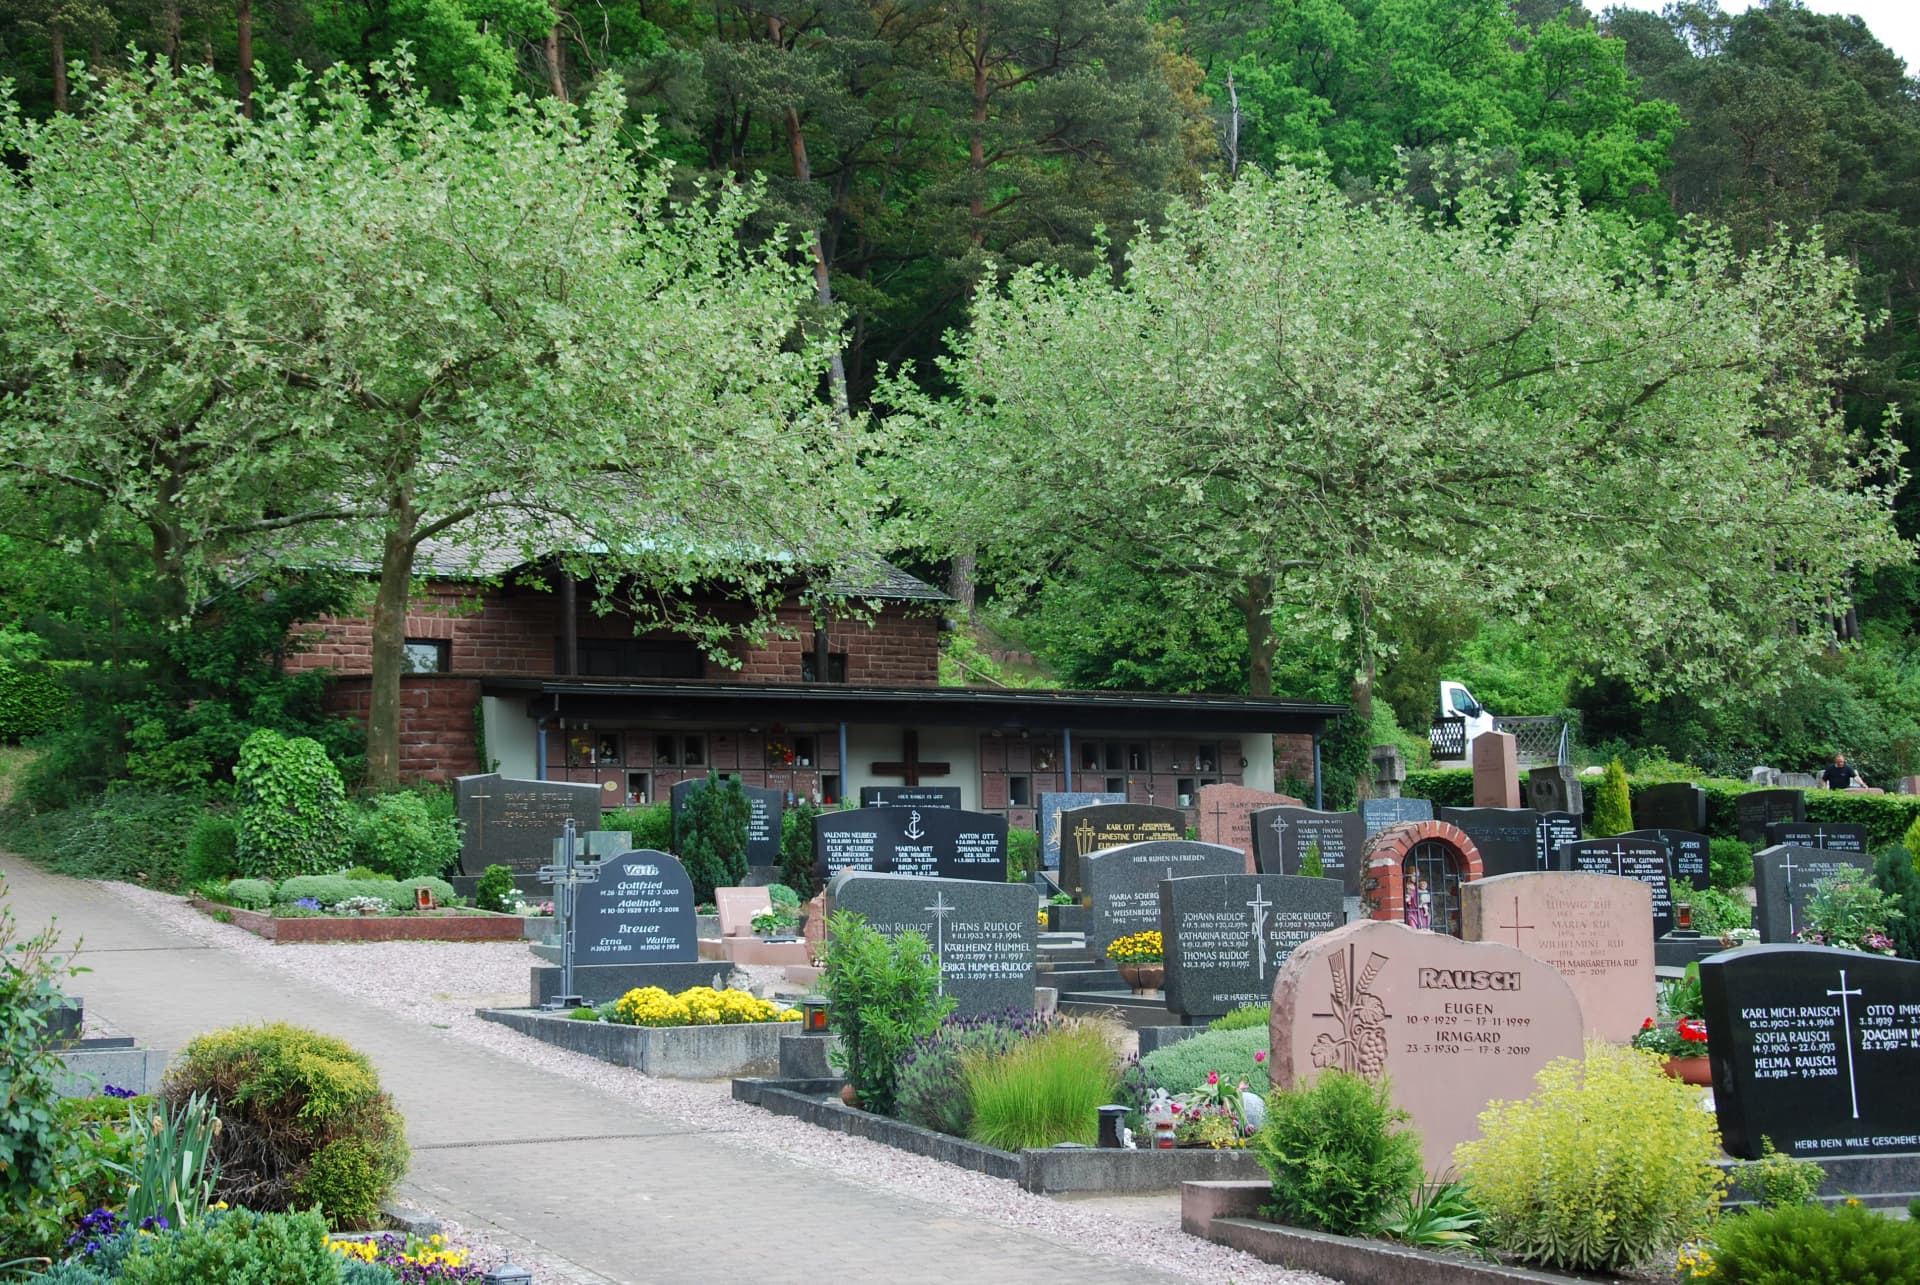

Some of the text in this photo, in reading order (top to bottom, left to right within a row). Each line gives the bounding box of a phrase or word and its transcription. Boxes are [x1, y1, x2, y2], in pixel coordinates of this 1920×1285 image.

[1106, 823, 1122, 831] KARL
[1123, 823, 1135, 831] OTT
[1098, 833, 1130, 841] ERNESTINE
[1133, 833, 1145, 841] OTT
[618, 881, 663, 891] Gottfried
[1109, 893, 1132, 901] MARIA
[617, 899, 661, 908] Adelinde
[1183, 912, 1247, 922] JOHANN RUDLOF
[1276, 912, 1333, 921] GEORG RUDLOF
[618, 924, 661, 934] Breuer
[951, 921, 1023, 931] HANS RUDLOF
[1552, 921, 1587, 929] MARIA
[1178, 931, 1251, 941] KATHARINA RUDLOF
[1270, 931, 1309, 940] ELISABETH
[600, 936, 677, 946] Erna Walter
[1607, 940, 1624, 948] RUF
[944, 942, 1032, 952] KARLHEINZ HUMMEL
[1183, 951, 1250, 960] THOMAS RUDLOF
[943, 962, 966, 971] ERIKA
[1567, 960, 1640, 968] MARGARETHA RUF
[1560, 968, 1576, 976] 1920
[1418, 967, 1521, 991] RAUSCH
[1213, 993, 1229, 1001] HIER
[1444, 1002, 1494, 1015] EUGEN
[1741, 1005, 1841, 1020] KARL MICH. RAUSCH
[1866, 1004, 1895, 1016] OTTO
[1436, 1031, 1501, 1043] IRMGARD
[1755, 1030, 1830, 1043] SOFIA RAUSCH
[1860, 1028, 1908, 1042] JOACHIM
[1755, 1055, 1836, 1069] HELMA RAUSCH
[1794, 1140, 1819, 1150] HERR
[1820, 1139, 1842, 1149] DEIN
[1844, 1138, 1870, 1147] WILLE
